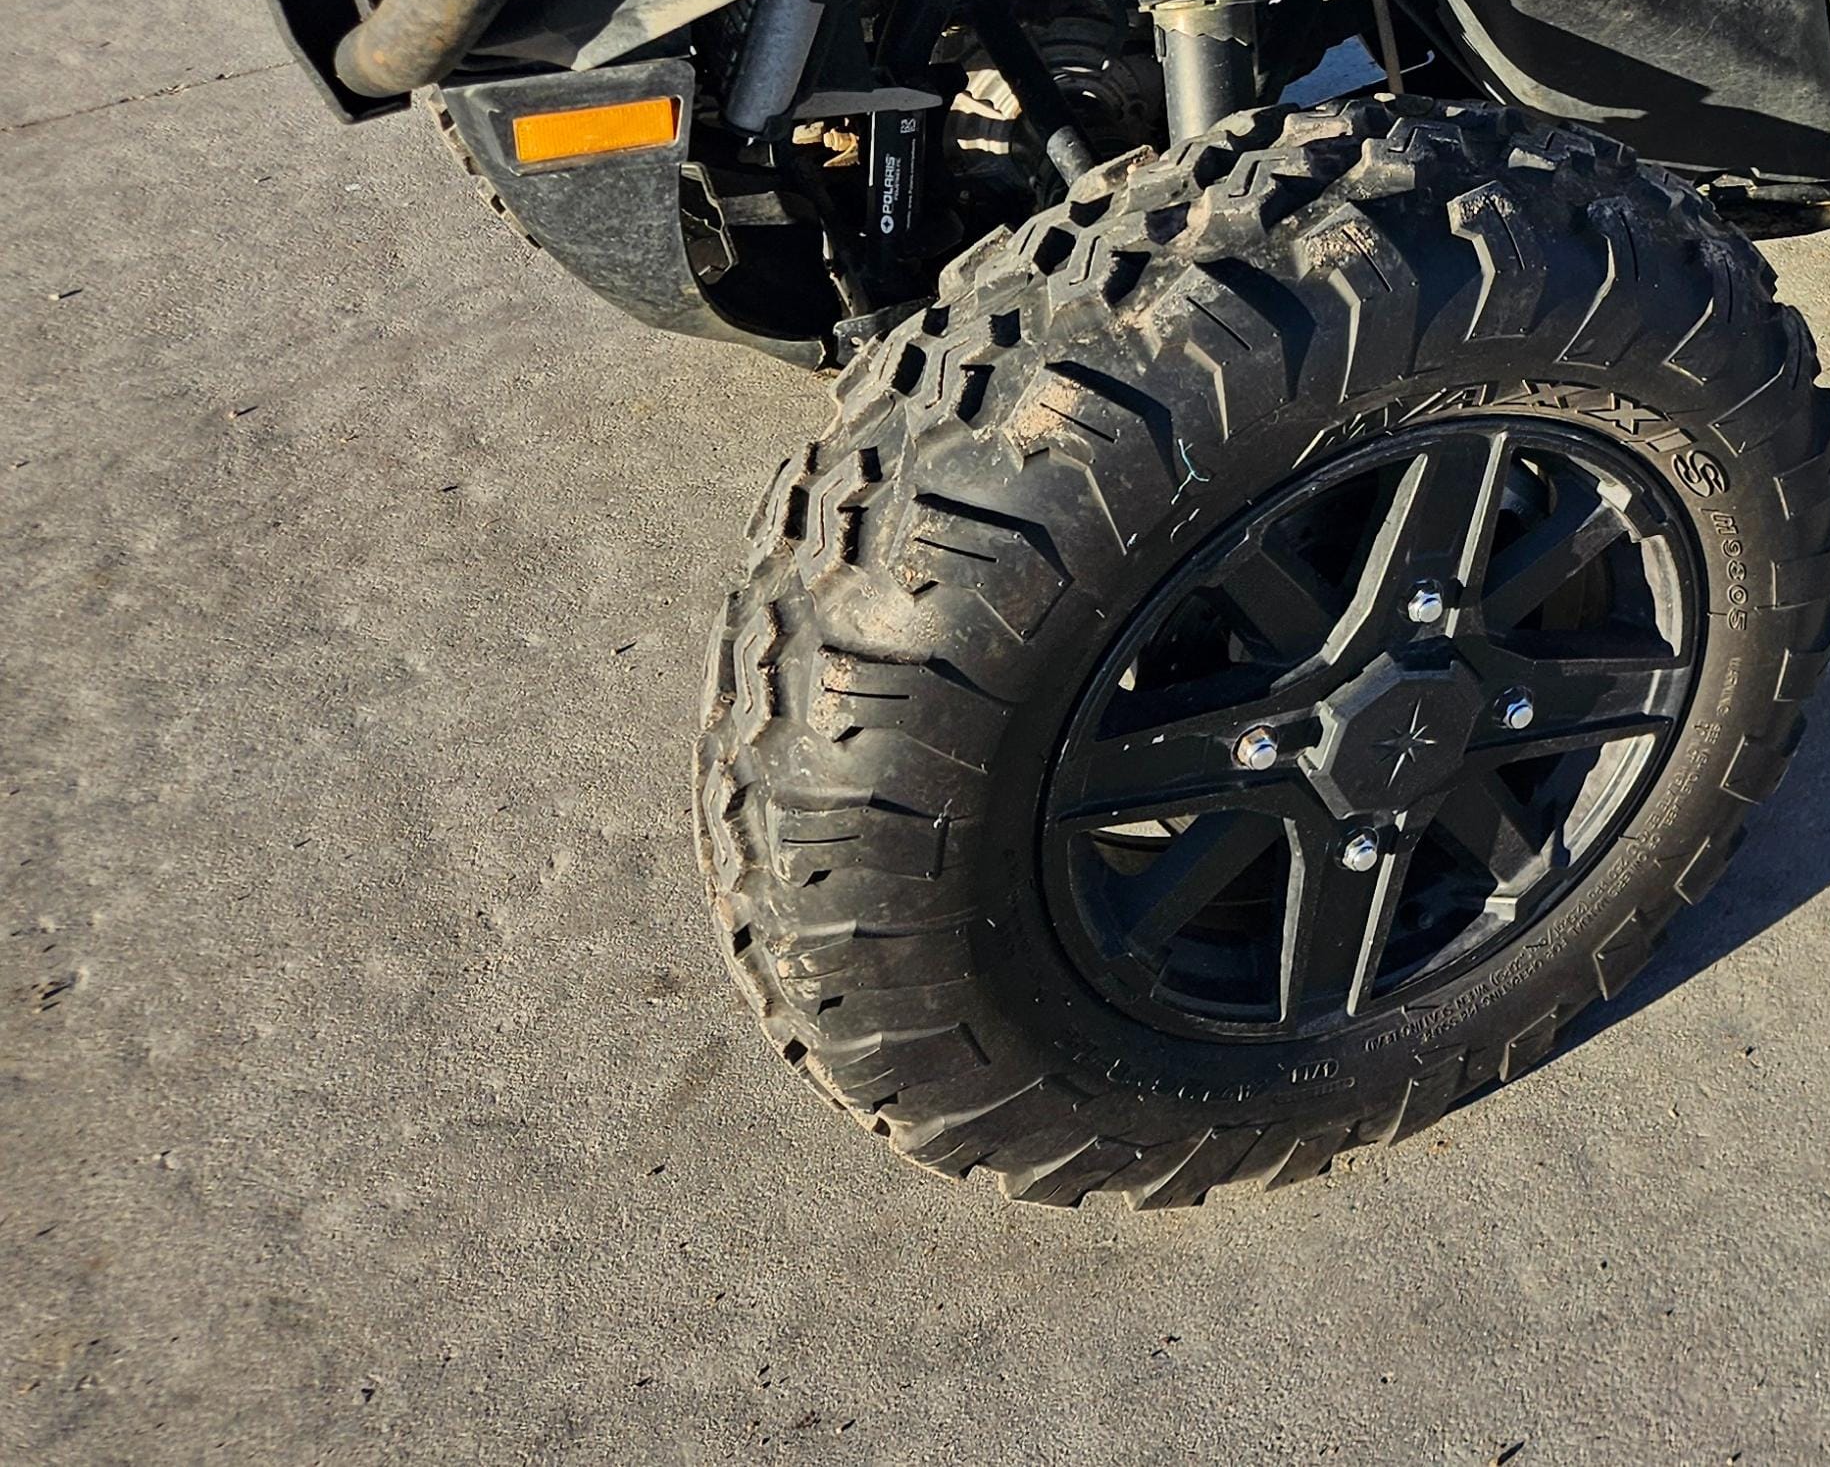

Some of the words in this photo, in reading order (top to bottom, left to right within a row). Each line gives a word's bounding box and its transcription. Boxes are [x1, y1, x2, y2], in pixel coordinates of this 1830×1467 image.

[882, 155, 896, 214] POLARIS
[1292, 378, 1728, 499] MAXXIS
[1710, 511, 1748, 631] M9805
